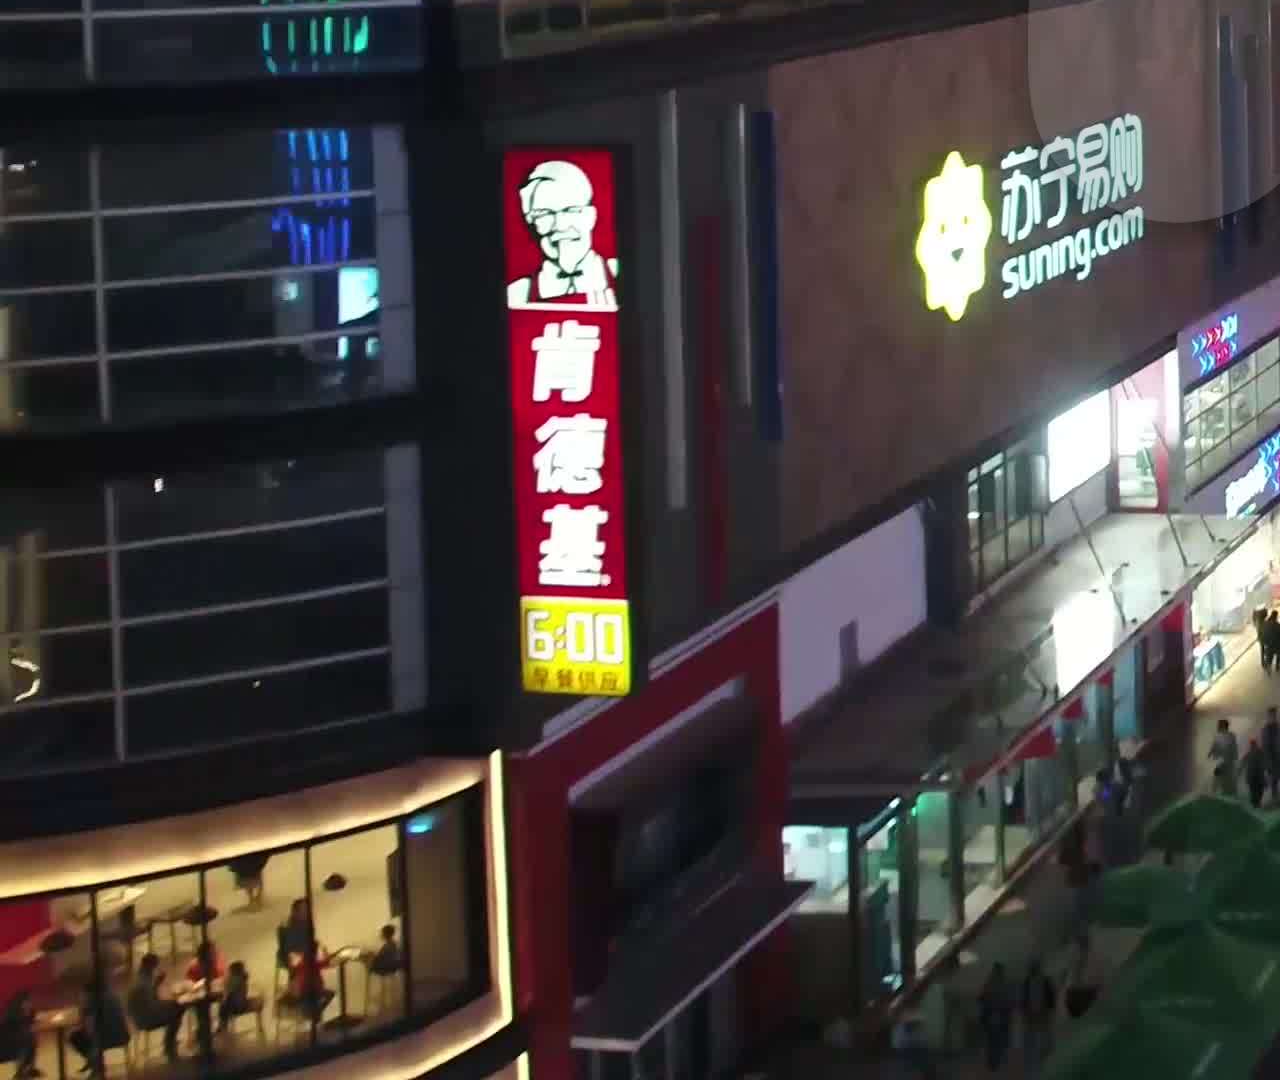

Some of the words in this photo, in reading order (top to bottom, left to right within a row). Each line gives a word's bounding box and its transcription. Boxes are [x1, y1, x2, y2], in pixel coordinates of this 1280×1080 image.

[1001, 113, 1144, 245] 苏宁易购
[1002, 206, 1144, 300] suning.com
[531, 320, 611, 587] 肯德基
[527, 610, 624, 664] 6:00
